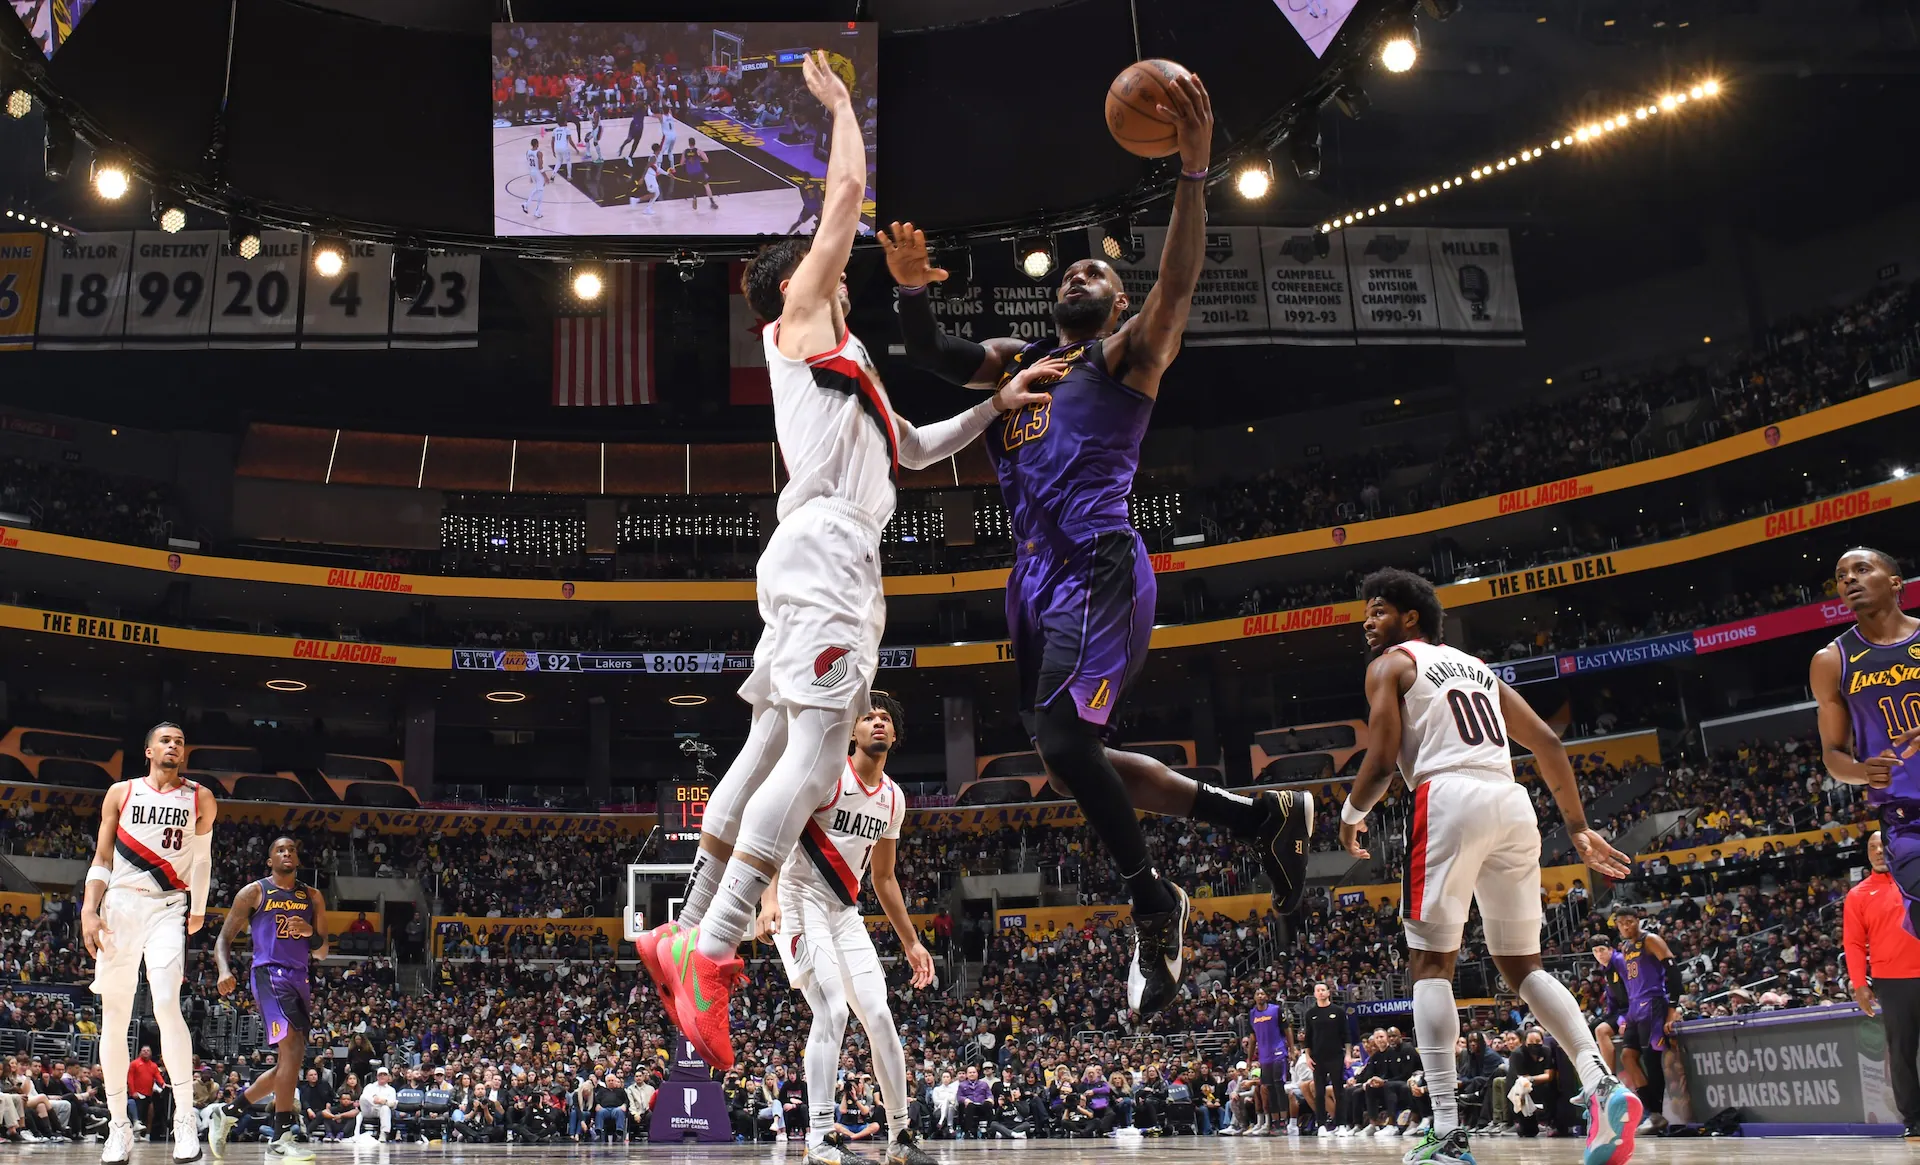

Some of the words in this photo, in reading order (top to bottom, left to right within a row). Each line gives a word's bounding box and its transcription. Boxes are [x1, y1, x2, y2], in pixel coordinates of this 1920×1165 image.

[62, 244, 117, 259] TAYLOR
[140, 244, 209, 258] GRETZKY
[1442, 242, 1499, 255] MILLER
[1277, 269, 1335, 280] CAMPBELL
[1369, 268, 1412, 279] SMYTHE
[993, 287, 1050, 299] STANLEY
[1271, 281, 1344, 293] CONFERENCE
[1368, 281, 1418, 291] DIVISION
[58, 273, 108, 318] 18
[139, 271, 204, 317] 99
[222, 270, 290, 317] 20
[329, 271, 362, 317] 4
[406, 271, 467, 318] 23
[1191, 294, 1257, 305] CHAMPIONS
[1276, 294, 1341, 305] CHAMPIONS
[1362, 294, 1427, 305] CHAMPIONS
[1202, 311, 1249, 323] 2011-12
[1285, 310, 1337, 323] 1992-93
[1371, 309, 1422, 322] 1990-91
[1498, 490, 1531, 514] CALL
[1765, 508, 1808, 538] CALL
[327, 568, 358, 588] CALL
[1488, 575, 1520, 597] THE
[1525, 566, 1568, 591] REAL
[1573, 556, 1617, 581] DEAL
[43, 613, 73, 633] THE
[77, 617, 116, 639] REAL
[122, 623, 160, 645] DEAL
[1243, 615, 1280, 636] CALL
[293, 639, 330, 660] CALL
[996, 644, 1015, 660] TH
[463, 658, 471, 668] 4
[482, 658, 488, 668] 1
[548, 655, 570, 671] 92
[595, 659, 632, 669] Lakers
[653, 655, 699, 672] 8:05
[711, 660, 720, 672] 4
[727, 659, 747, 668] Trail
[880, 657, 888, 667] 2
[900, 657, 907, 667] 2
[1425, 661, 1494, 691] HENDERSON
[1446, 688, 1505, 748] 00
[677, 787, 710, 801] 8:05
[132, 805, 190, 828] BLAZERS
[282, 807, 344, 824] LOS
[353, 811, 488, 831] ANGELES
[496, 815, 620, 833] LAKERS
[972, 805, 1080, 825] LAKER
[161, 827, 183, 851] 33
[1342, 893, 1361, 906] 117
[1003, 917, 1023, 928] 116
[1357, 1003, 1372, 1015] 17x
[1693, 1052, 1724, 1076] THE
[1725, 1047, 1778, 1074] GO-TO
[1780, 1042, 1843, 1071] SNACK
[1706, 1084, 1727, 1109] OF
[1727, 1081, 1791, 1108] LAKERS
[1794, 1079, 1841, 1106] FANS
[671, 1117, 709, 1126] PECHANGA
